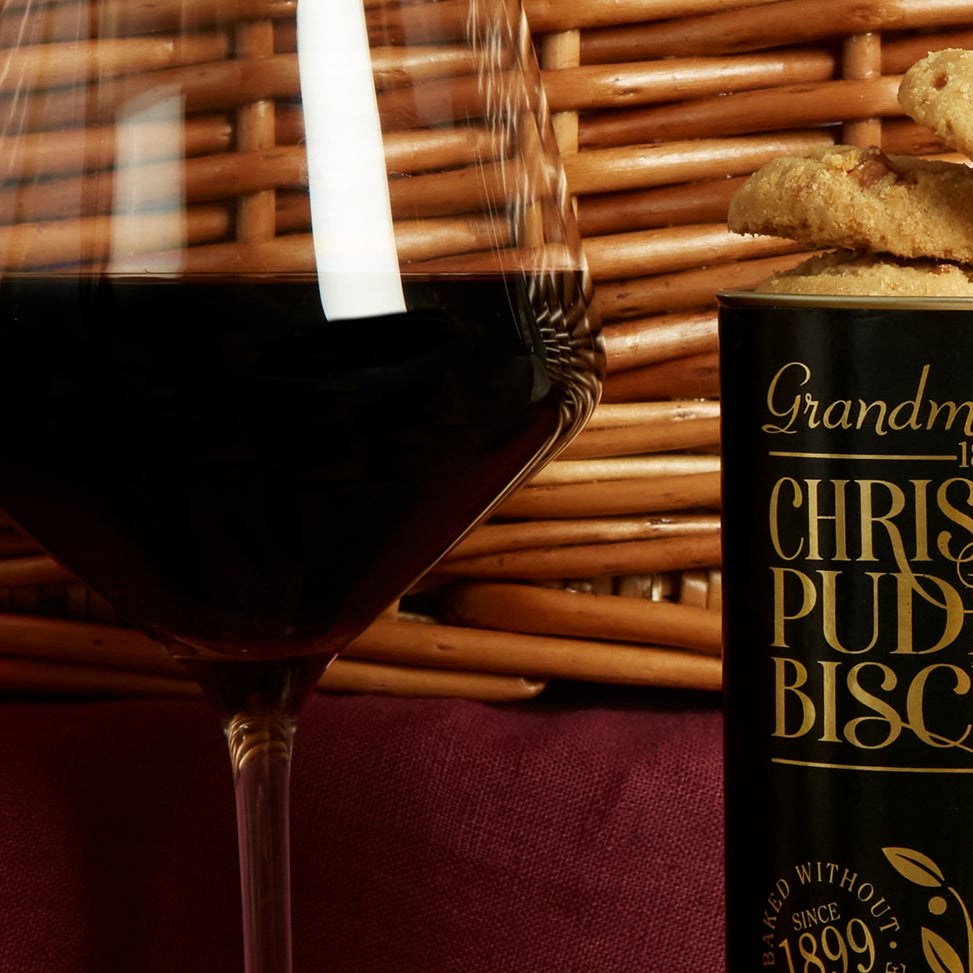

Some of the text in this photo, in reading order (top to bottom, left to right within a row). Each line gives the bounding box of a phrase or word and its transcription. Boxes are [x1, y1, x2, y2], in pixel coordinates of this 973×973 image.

[762, 861, 900, 966] BAKED WITHOUT
[791, 902, 841, 931] SINCE
